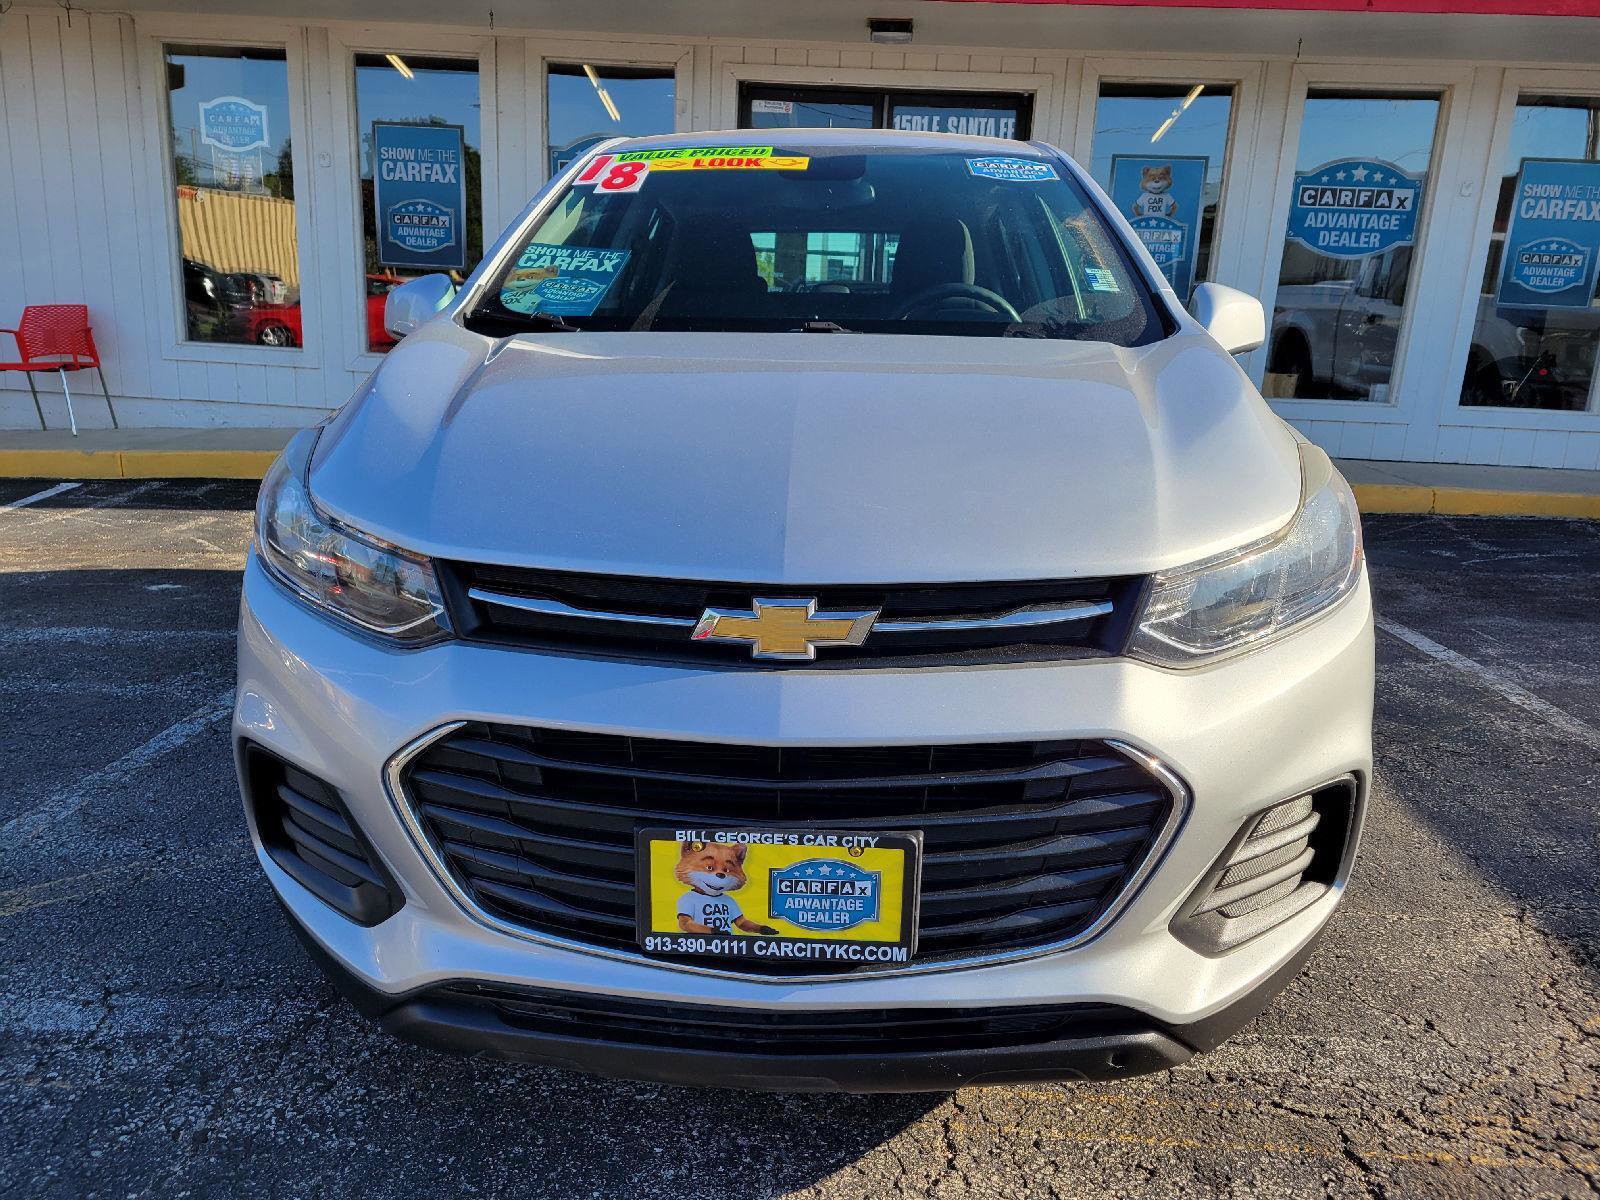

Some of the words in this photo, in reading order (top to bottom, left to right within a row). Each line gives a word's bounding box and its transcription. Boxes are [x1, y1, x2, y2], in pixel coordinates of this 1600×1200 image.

[893, 114, 929, 131] 1501
[947, 116, 996, 137] SANTA
[380, 147, 415, 160] SHOW
[418, 149, 433, 161] ME
[437, 150, 456, 162] THE
[619, 150, 684, 161] VALUE
[690, 148, 767, 157] PRICED
[693, 157, 764, 168] LOOK
[382, 161, 456, 183] CARFAX
[1523, 183, 1563, 198] SHOW
[1564, 185, 1583, 199] ME
[1586, 185, 1600, 199] TH
[1147, 197, 1163, 205] CAR
[1303, 189, 1409, 210] CARFAX
[1148, 205, 1162, 213] FOX
[1520, 198, 1600, 222] CARFAX
[394, 215, 448, 226] CARFAX
[1304, 211, 1400, 230] ADVANTAGE
[397, 227, 445, 237] ADVANTAGE
[1142, 232, 1180, 242] RFAX
[406, 236, 437, 246] DEALER
[1318, 230, 1381, 248] DEALER
[525, 245, 571, 257] SHOW
[573, 249, 596, 259] ME
[518, 253, 621, 272] CARFAX
[1522, 253, 1580, 266] CARFAX
[1522, 266, 1576, 277] ADVANTAGE
[1529, 276, 1565, 287] DEALER
[675, 830, 711, 842] BILL
[714, 831, 799, 845] GEORGE'S
[803, 834, 838, 847] CAR
[841, 836, 879, 848] CITY
[780, 880, 868, 896] CARFAX
[702, 904, 730, 916] CAR
[784, 897, 864, 911] ADVANTAGE
[703, 917, 731, 929] FOX
[798, 911, 850, 924] DEALER
[645, 936, 747, 955] 913-390-0111
[753, 941, 908, 962] CARCITYKC.COM
